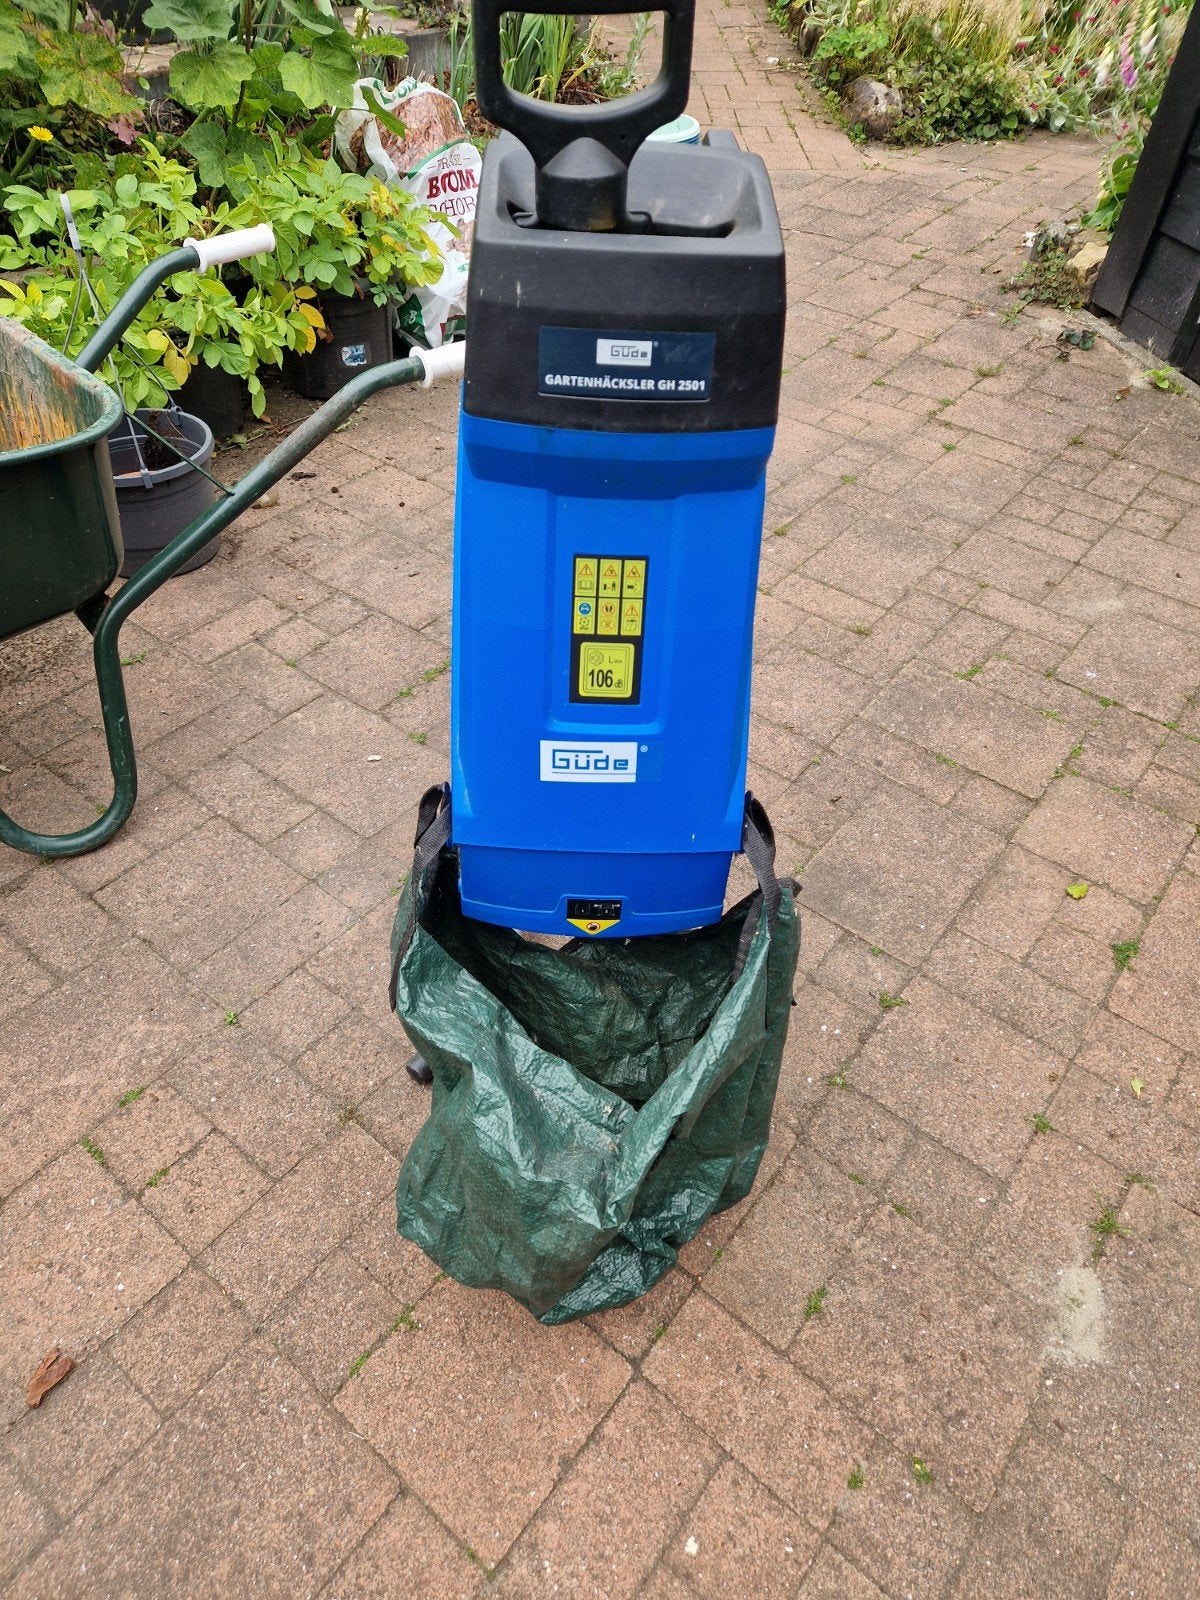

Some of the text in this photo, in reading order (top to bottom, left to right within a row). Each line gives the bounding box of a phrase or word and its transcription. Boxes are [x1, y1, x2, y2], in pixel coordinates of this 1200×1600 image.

[610, 345, 648, 358] Güde
[545, 374, 705, 391] GARTENHÄCKSLER GH 2501
[588, 669, 613, 688] 106
[552, 749, 629, 770] Güde
